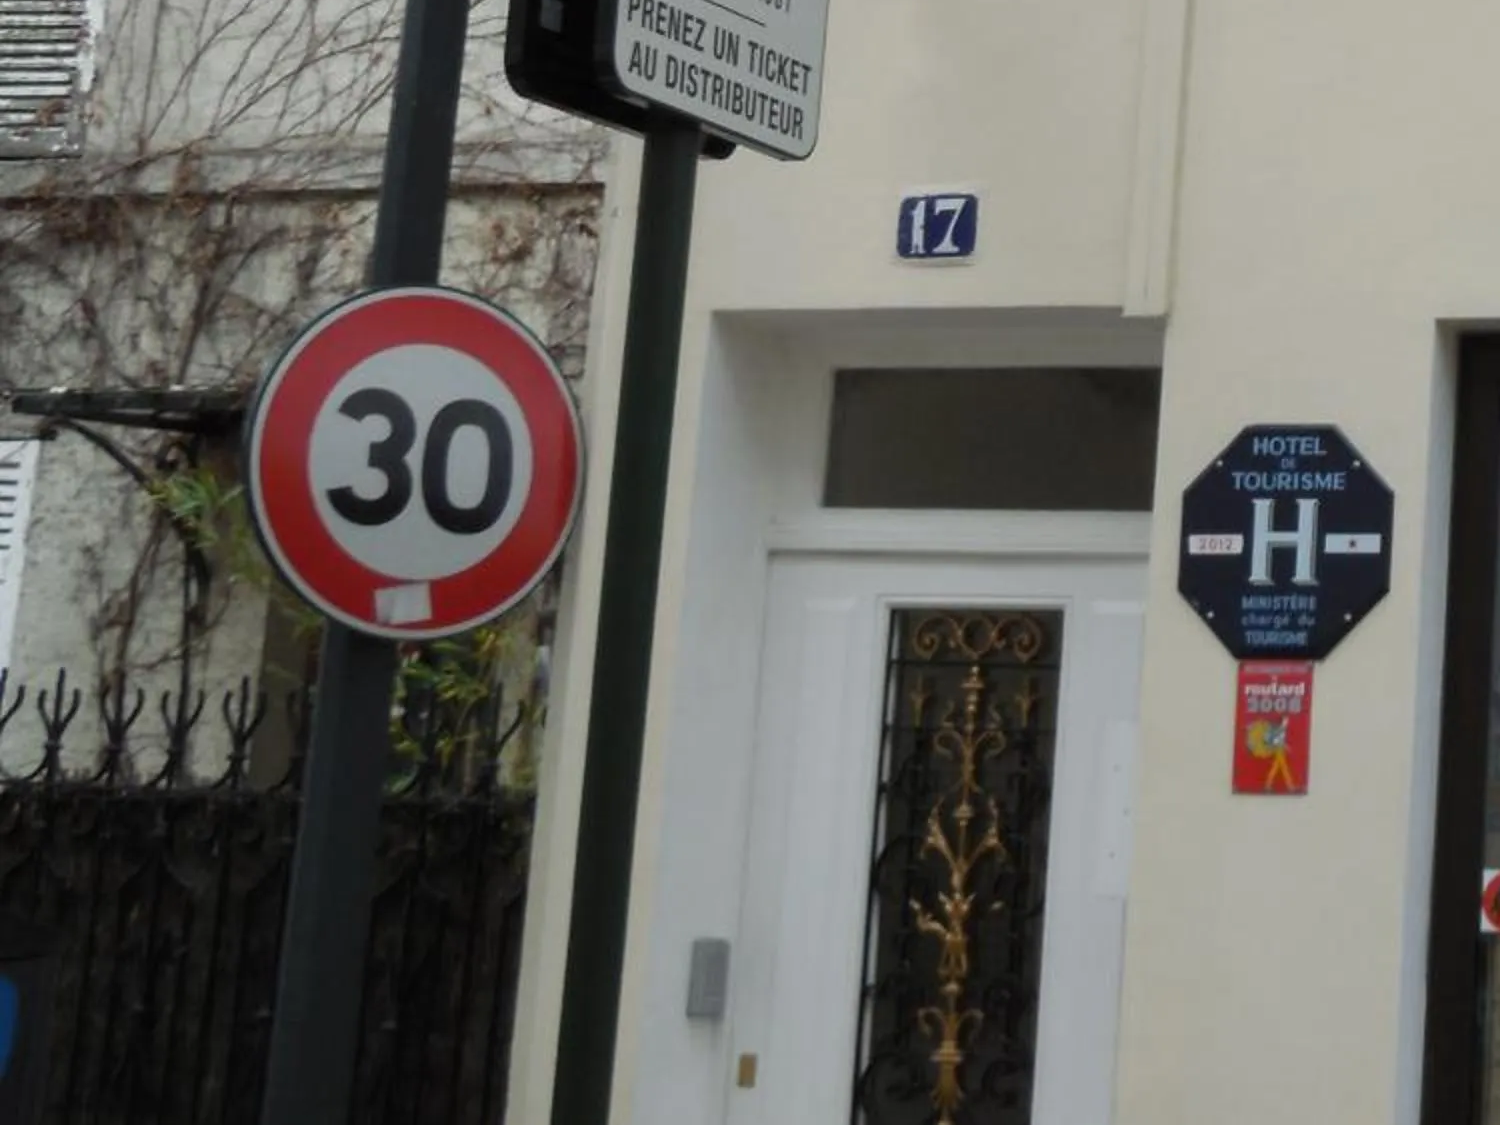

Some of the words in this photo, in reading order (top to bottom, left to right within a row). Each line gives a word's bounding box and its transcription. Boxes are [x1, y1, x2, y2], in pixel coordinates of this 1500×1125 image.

[628, 41, 658, 80] AU
[666, 55, 803, 140] DISTRIBUTEUR
[713, 26, 740, 67] UN
[748, 41, 812, 96] TICKET
[909, 198, 966, 254] 17
[327, 388, 513, 535] 30
[1232, 472, 1347, 490] TOURISME
[1252, 436, 1328, 456] HOTEL
[1248, 498, 1319, 586] H
